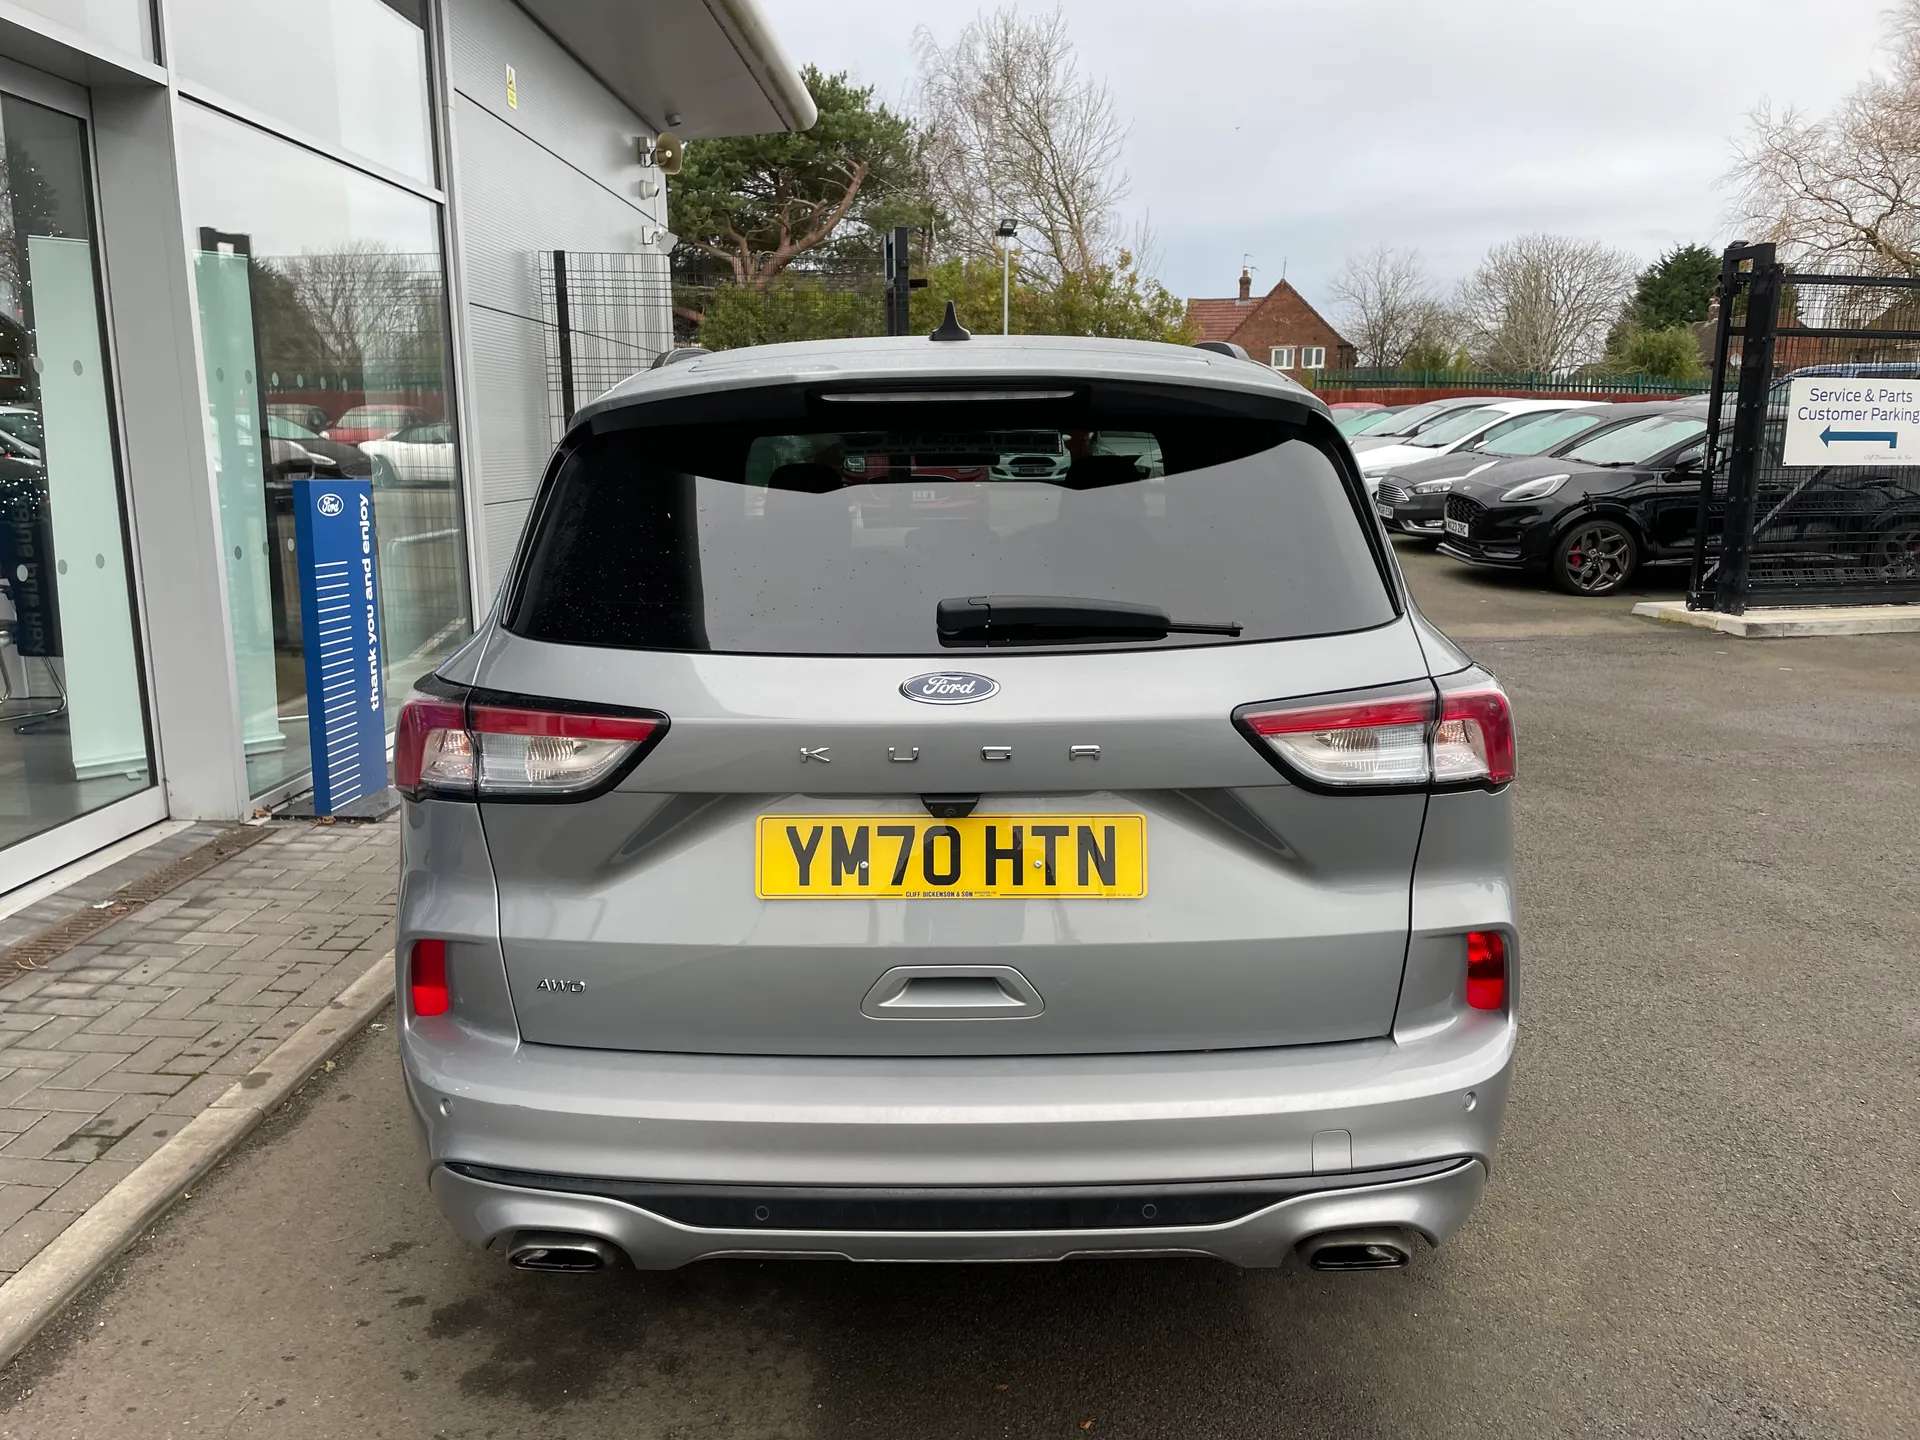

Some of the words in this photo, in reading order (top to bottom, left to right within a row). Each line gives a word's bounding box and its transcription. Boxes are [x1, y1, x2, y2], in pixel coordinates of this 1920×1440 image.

[1797, 406, 1868, 421] Customer
[1871, 407, 1920, 424] Parking
[1809, 388, 1862, 402] Service
[1864, 388, 1875, 402] &
[1879, 389, 1913, 403] Parts
[359, 493, 370, 554] enjoy
[362, 557, 373, 601] and
[366, 604, 378, 646] you
[368, 645, 380, 712] thank
[800, 745, 1101, 763] KUGA
[785, 825, 961, 887] YM70
[984, 825, 1116, 887] HTN
[537, 978, 586, 993] AWD
